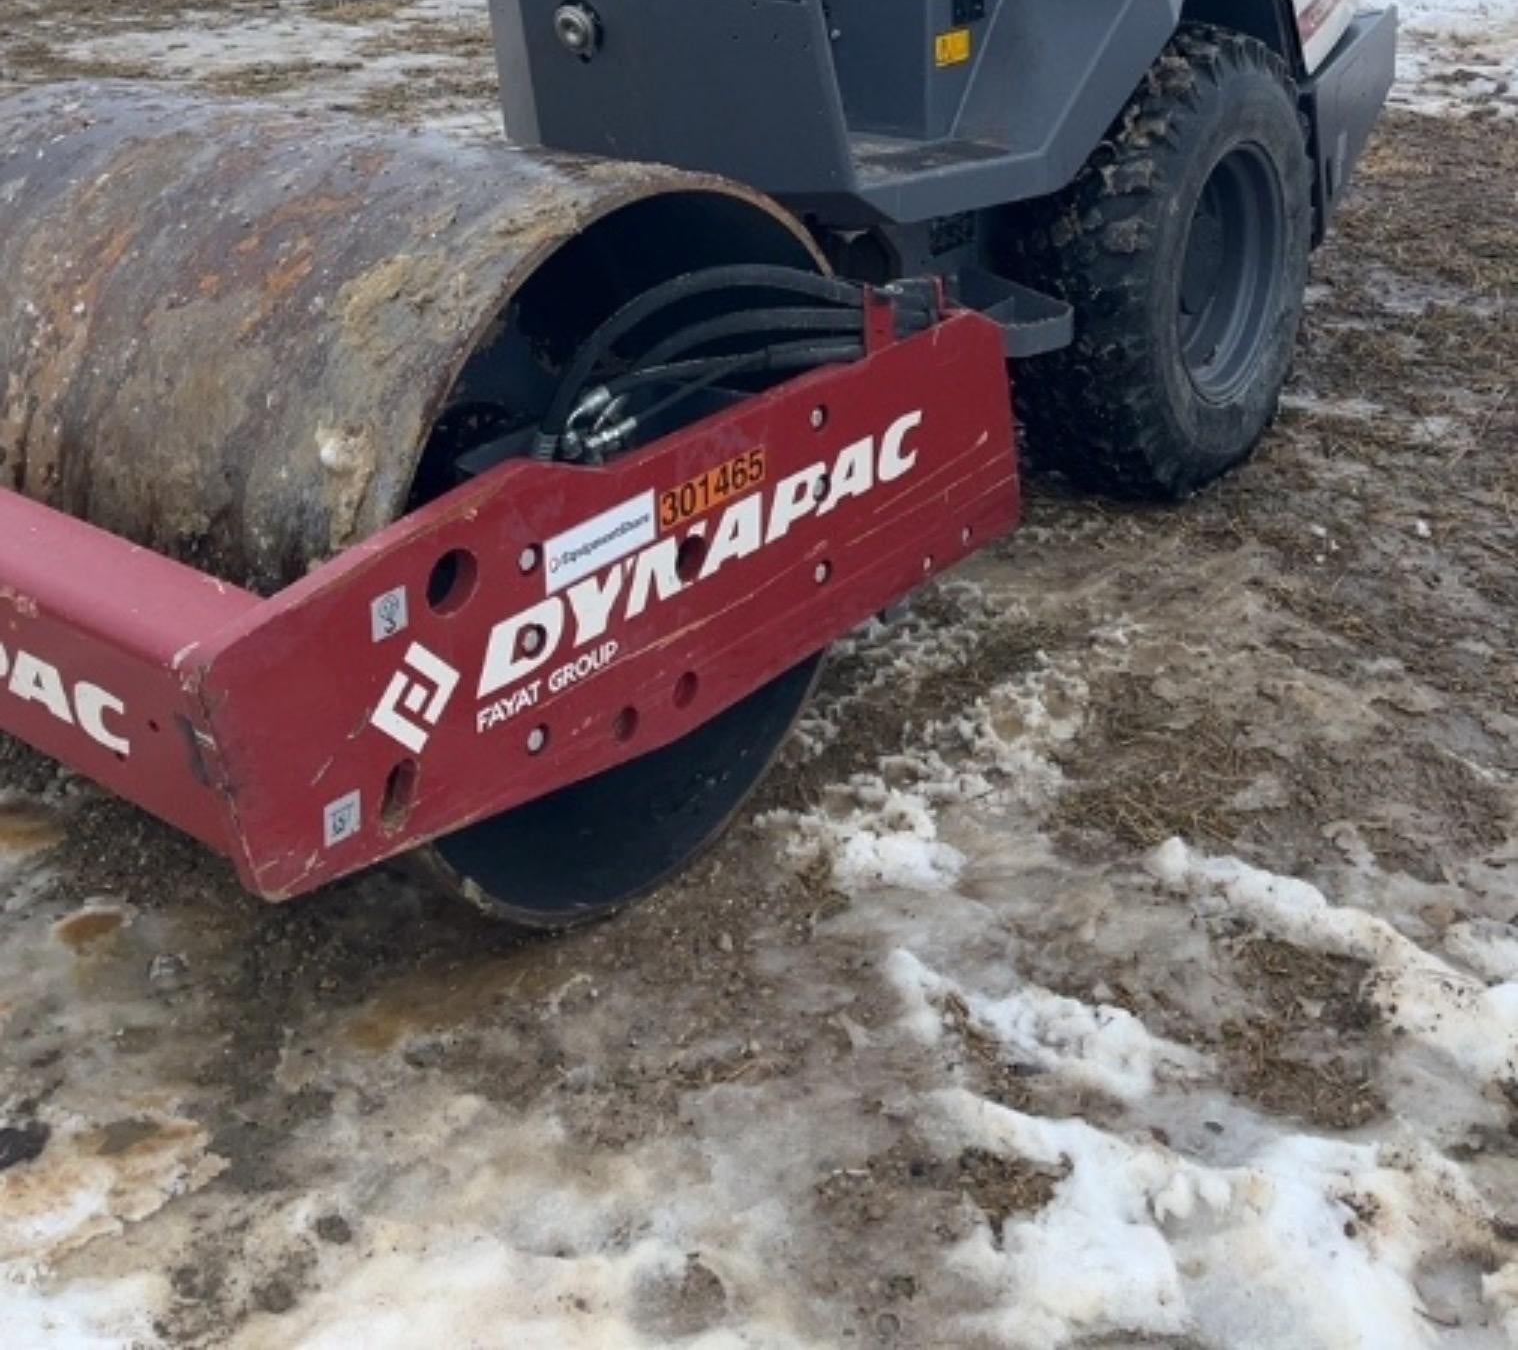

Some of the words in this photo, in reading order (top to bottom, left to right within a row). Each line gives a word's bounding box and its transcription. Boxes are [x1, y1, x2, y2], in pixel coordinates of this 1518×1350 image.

[662, 450, 763, 526] 301465
[477, 411, 922, 699] DYNAPAC
[0, 641, 130, 756] AC
[476, 680, 541, 733] FAYAT
[549, 640, 618, 692] GROUP
